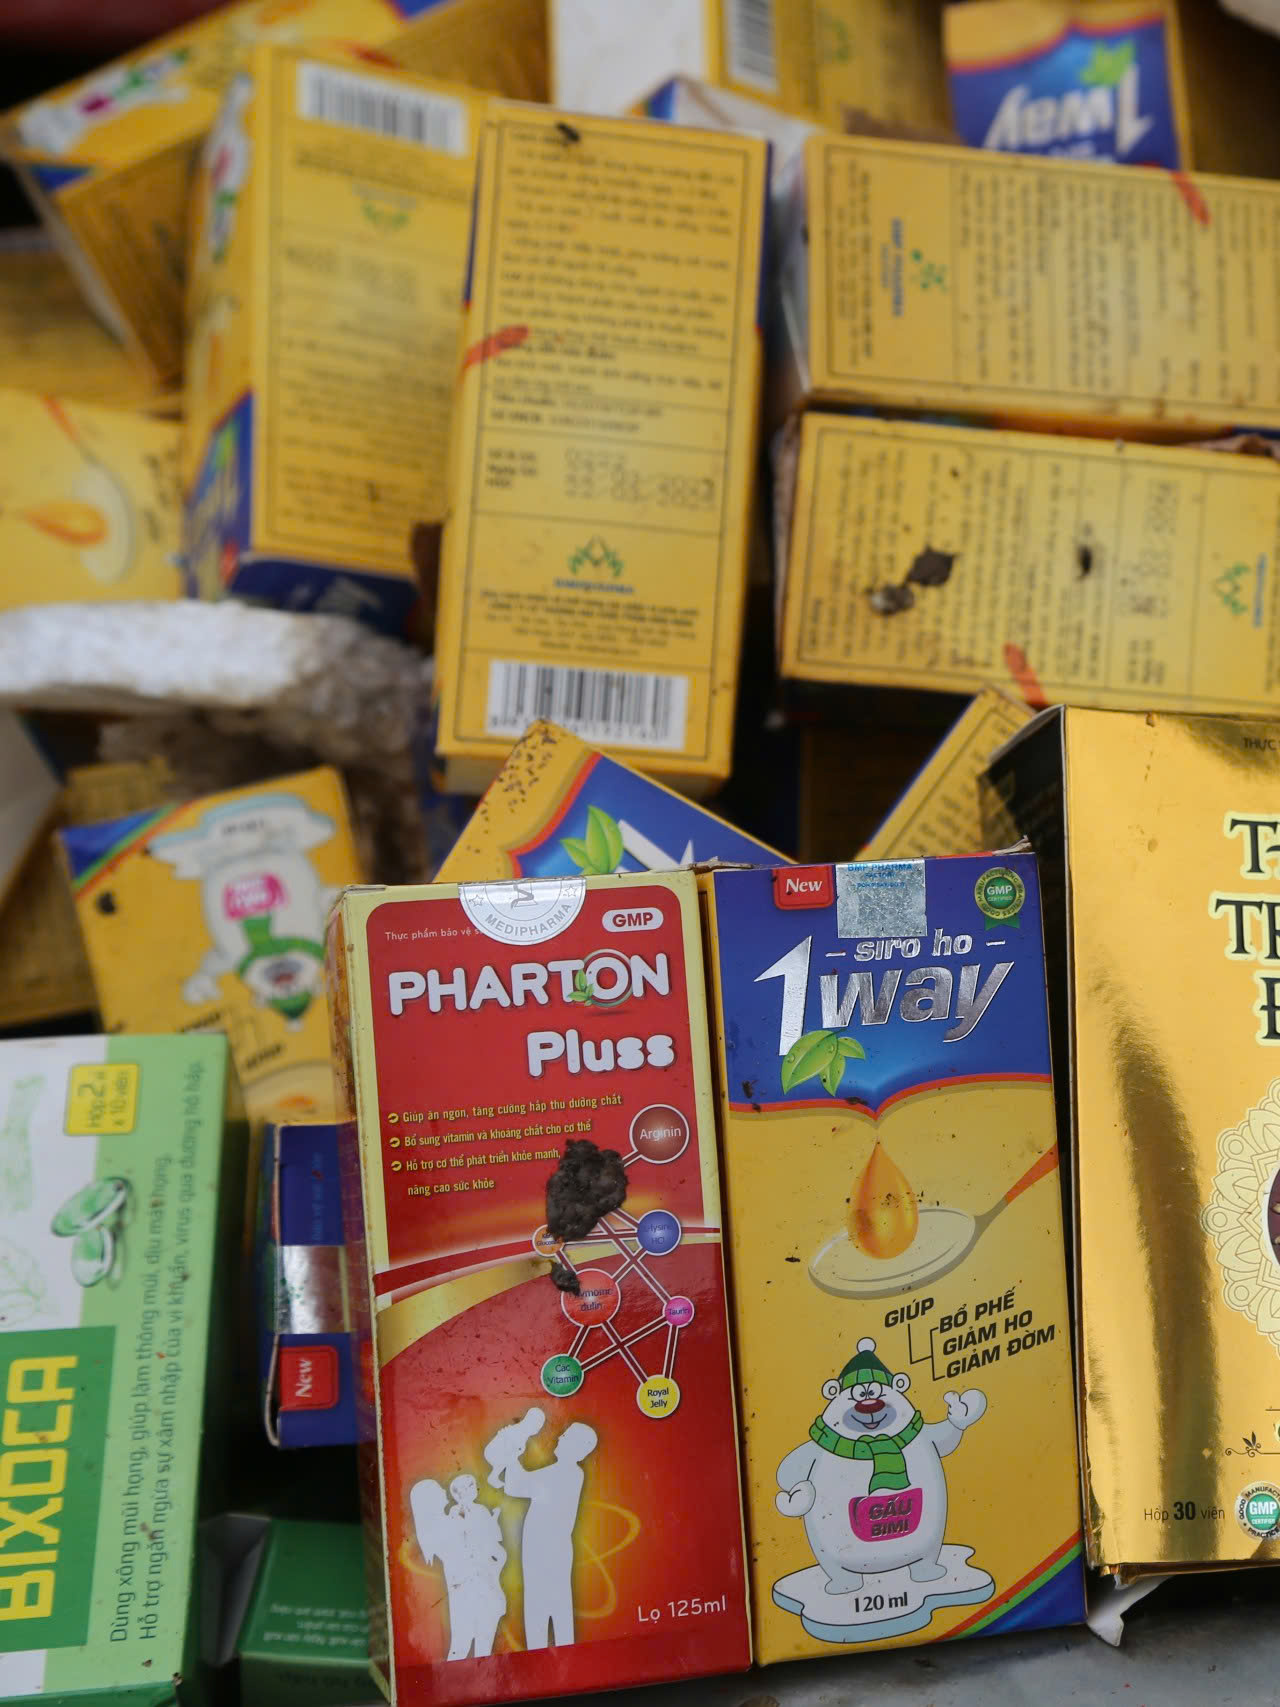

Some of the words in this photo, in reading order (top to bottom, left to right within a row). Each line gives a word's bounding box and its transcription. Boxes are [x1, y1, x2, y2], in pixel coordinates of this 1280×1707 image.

[786, 878, 823, 894] New
[987, 885, 1012, 895] GMP
[385, 931, 409, 942] Thực
[411, 926, 438, 940] phẩm
[440, 926, 458, 937] bảo
[485, 903, 573, 937] MEDIPHARMA
[612, 912, 654, 928] GMP
[854, 938, 921, 962] siro
[933, 929, 972, 957] ho
[388, 952, 671, 1016] PHARTON
[526, 1028, 675, 1078] Pluss
[403, 1111, 424, 1123] Giúp
[443, 1109, 469, 1121] ngon,
[472, 1105, 494, 1118] tăng
[550, 1100, 566, 1110] thu
[600, 1094, 622, 1106] chất
[419, 1136, 441, 1147] sung
[443, 1132, 475, 1144] vitamin
[477, 1129, 488, 1141] và
[490, 1126, 522, 1139] khoáng
[524, 1123, 544, 1136] chất
[546, 1123, 562, 1135] cho
[564, 1122, 575, 1133] cơ
[577, 1118, 592, 1132] thể
[639, 1126, 682, 1141] Arginin
[421, 1158, 434, 1172] trợ
[436, 1157, 447, 1168] cơ
[449, 1153, 465, 1167] thể
[467, 1153, 487, 1168] phát
[489, 1151, 509, 1164] triển
[511, 1149, 533, 1162] khỏe
[535, 1148, 561, 1162] mạnh,
[408, 1184, 431, 1197] nâng
[433, 1184, 450, 1193] cao
[453, 1181, 470, 1192] sức
[472, 1177, 495, 1189] khỏe
[884, 1297, 935, 1328] GIÚP
[938, 1304, 968, 1335] BỔ
[974, 1287, 1016, 1322] PHẾ
[136, 1310, 160, 1360] thông
[942, 1322, 998, 1357] GIẢM
[1003, 1309, 1033, 1332] HO
[946, 1344, 1000, 1379] GIẢM
[1006, 1325, 1056, 1358] ĐỜM
[131, 1366, 150, 1398] làm
[160, 1361, 183, 1406] nhập
[295, 1357, 313, 1399] New
[546, 1373, 580, 1385] Vitamin
[647, 1386, 670, 1399] Royal
[649, 1397, 668, 1410] Jelly
[128, 1402, 150, 1440] giúp
[155, 1411, 174, 1448] xâm
[123, 1447, 149, 1497] họng,
[157, 1452, 175, 1474] sự
[0, 1355, 78, 1622] BIXOCA
[151, 1478, 172, 1523] ngừa
[122, 1501, 139, 1535] mũi
[868, 1496, 913, 1522] GẤU
[1144, 1508, 1168, 1523] Hộp
[1173, 1501, 1196, 1520] 30
[1201, 1508, 1225, 1520] viên
[1249, 1501, 1278, 1515] GMP
[871, 1519, 910, 1537] BIMI
[116, 1541, 140, 1587] xông
[147, 1530, 168, 1575] ngăn
[142, 1580, 163, 1608] trợ
[638, 1606, 660, 1623] Lọ
[668, 1595, 727, 1618] 125ml
[855, 1595, 884, 1613] 120
[888, 1592, 909, 1609] ml
[110, 1592, 136, 1642] Dùng
[137, 1613, 158, 1640] Hỗ
